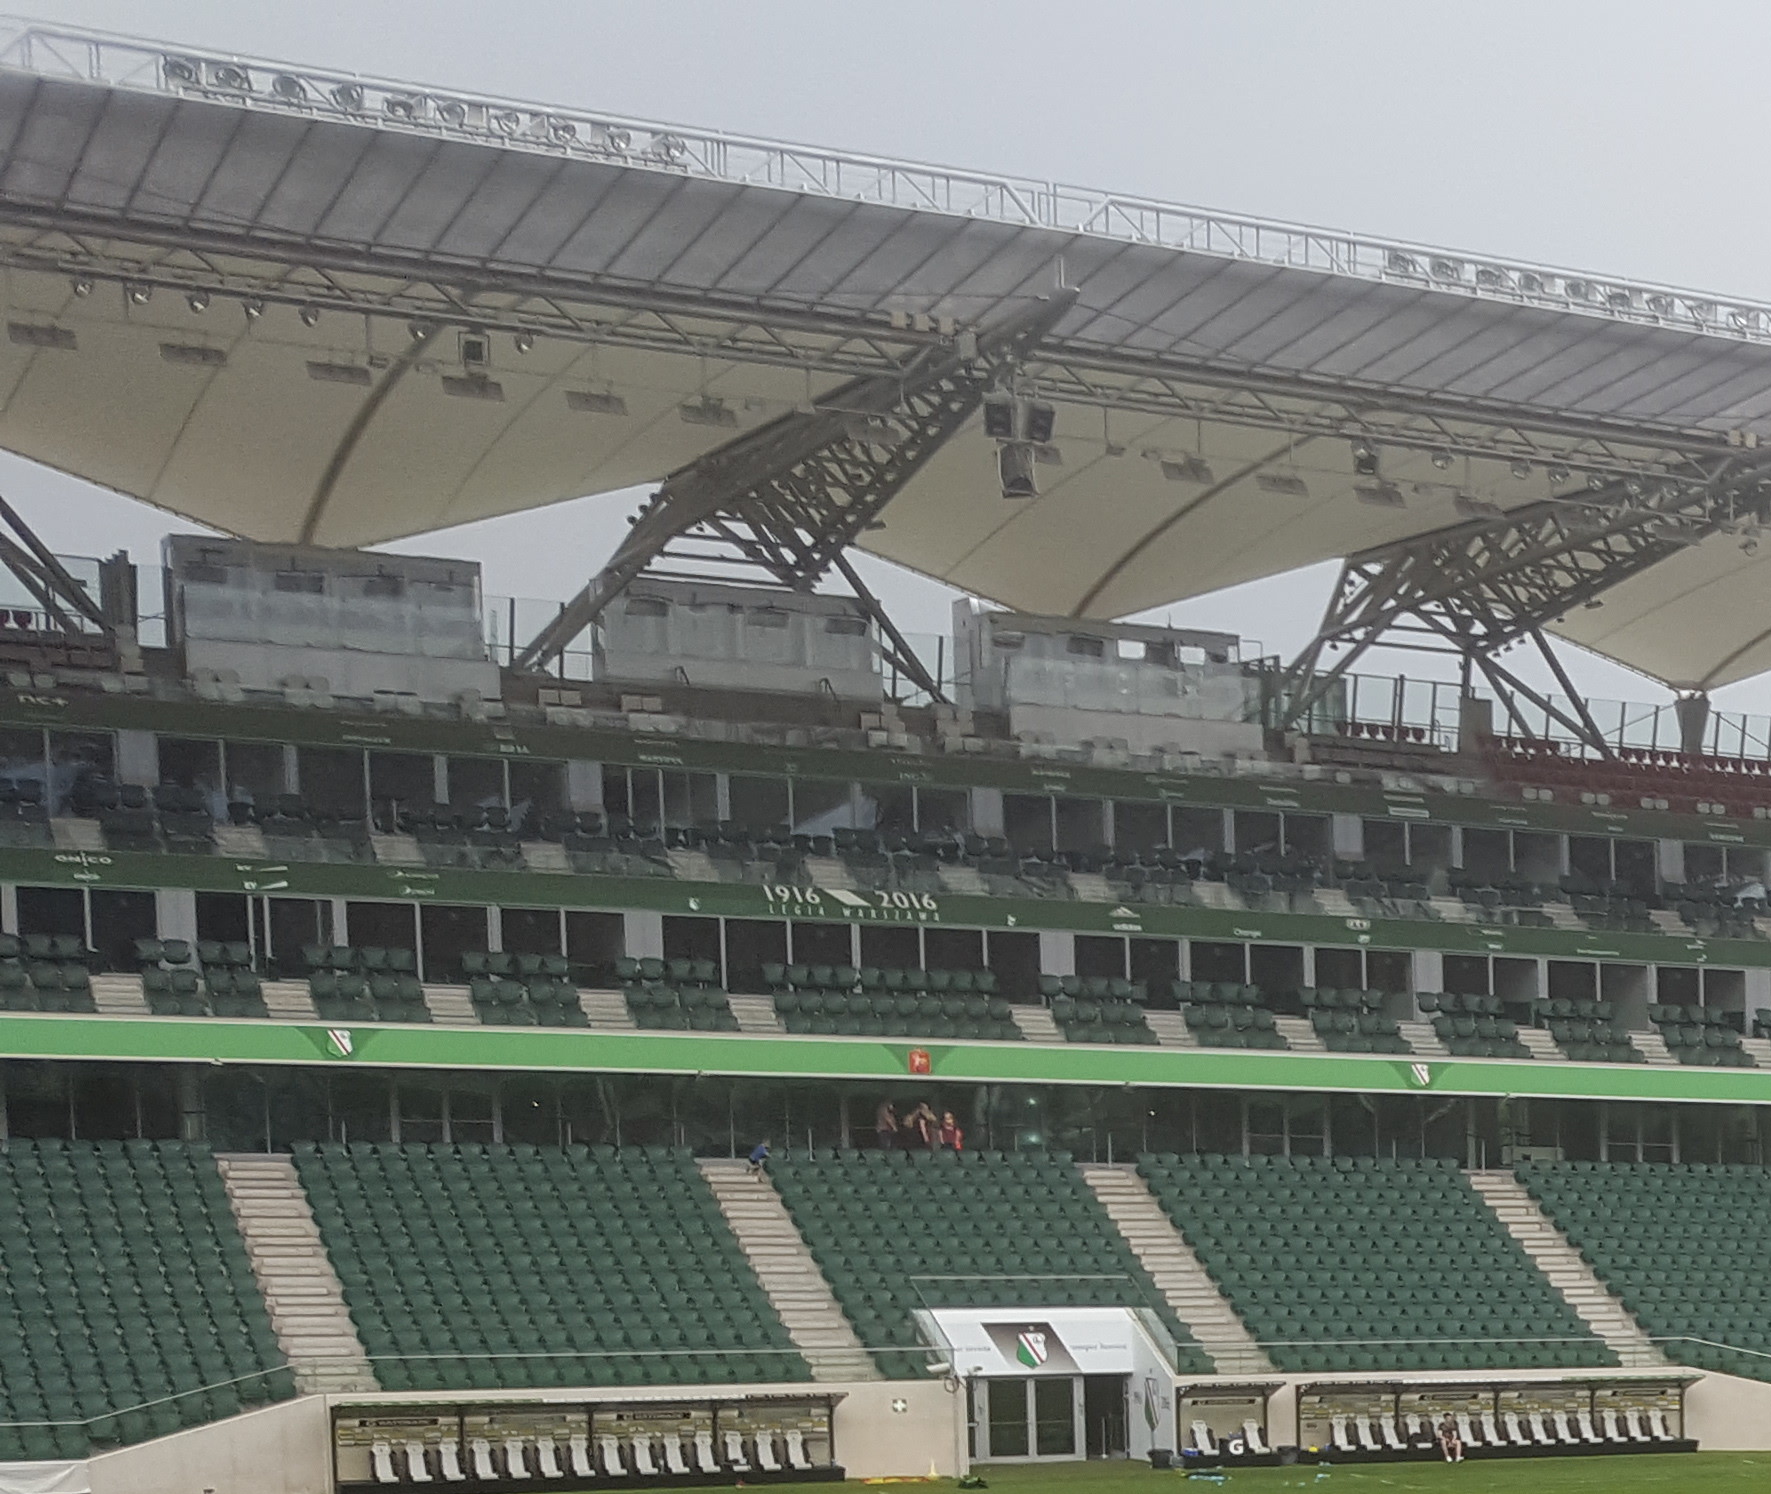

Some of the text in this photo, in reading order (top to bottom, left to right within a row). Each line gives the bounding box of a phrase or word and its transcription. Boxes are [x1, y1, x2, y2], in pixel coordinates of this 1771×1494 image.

[762, 884, 937, 910] 1916 2016
[769, 904, 940, 922] LEGIA WARSZAWA
